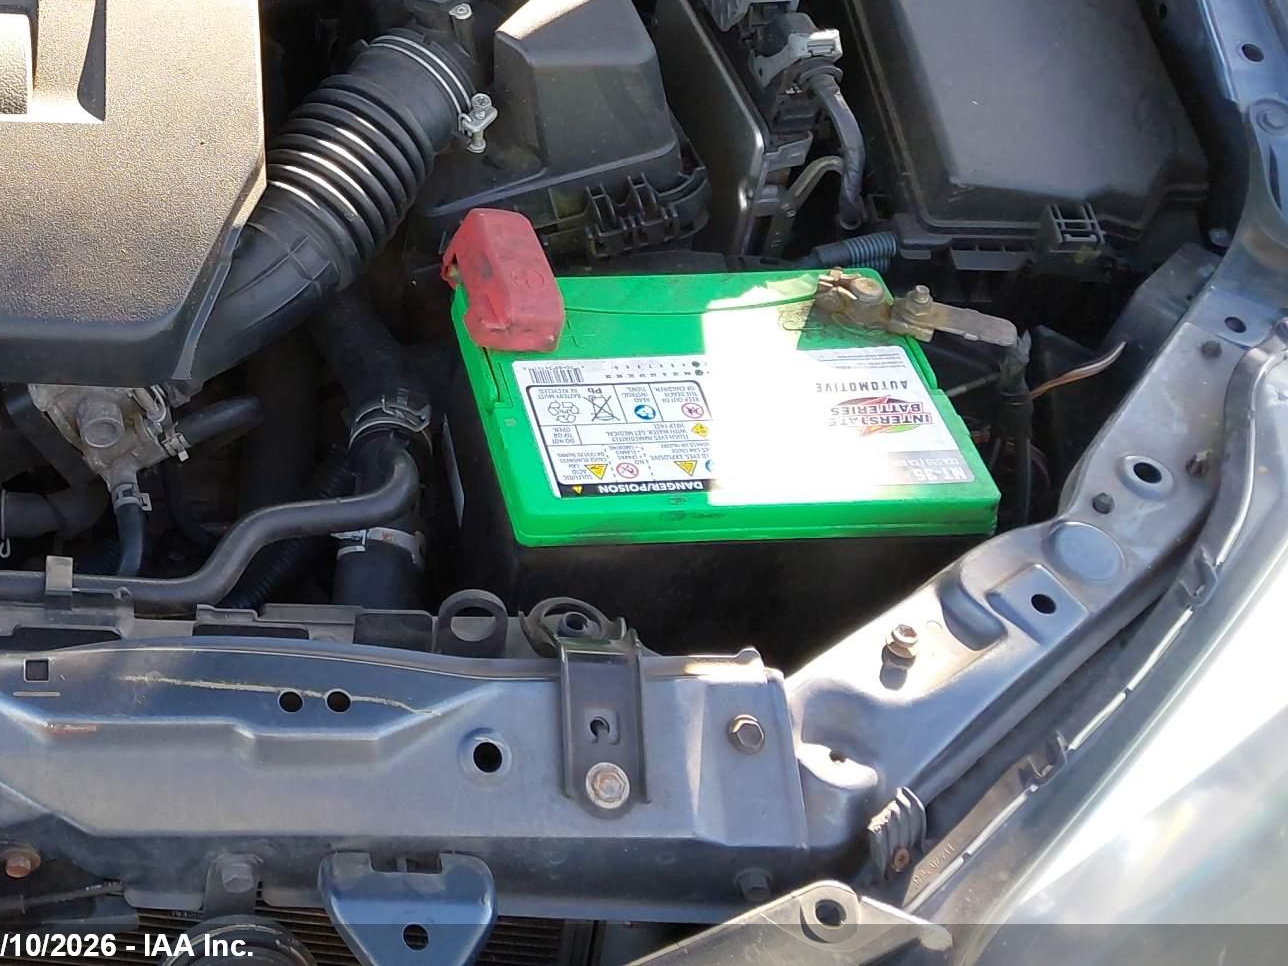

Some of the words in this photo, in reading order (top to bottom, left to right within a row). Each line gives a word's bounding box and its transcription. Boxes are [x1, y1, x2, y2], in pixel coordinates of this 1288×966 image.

[815, 380, 908, 392] AUTOMOTIVE
[830, 403, 921, 415] BATTERIES
[828, 414, 929, 426] INTERSTATE
[598, 481, 703, 493] DANGER/POISON
